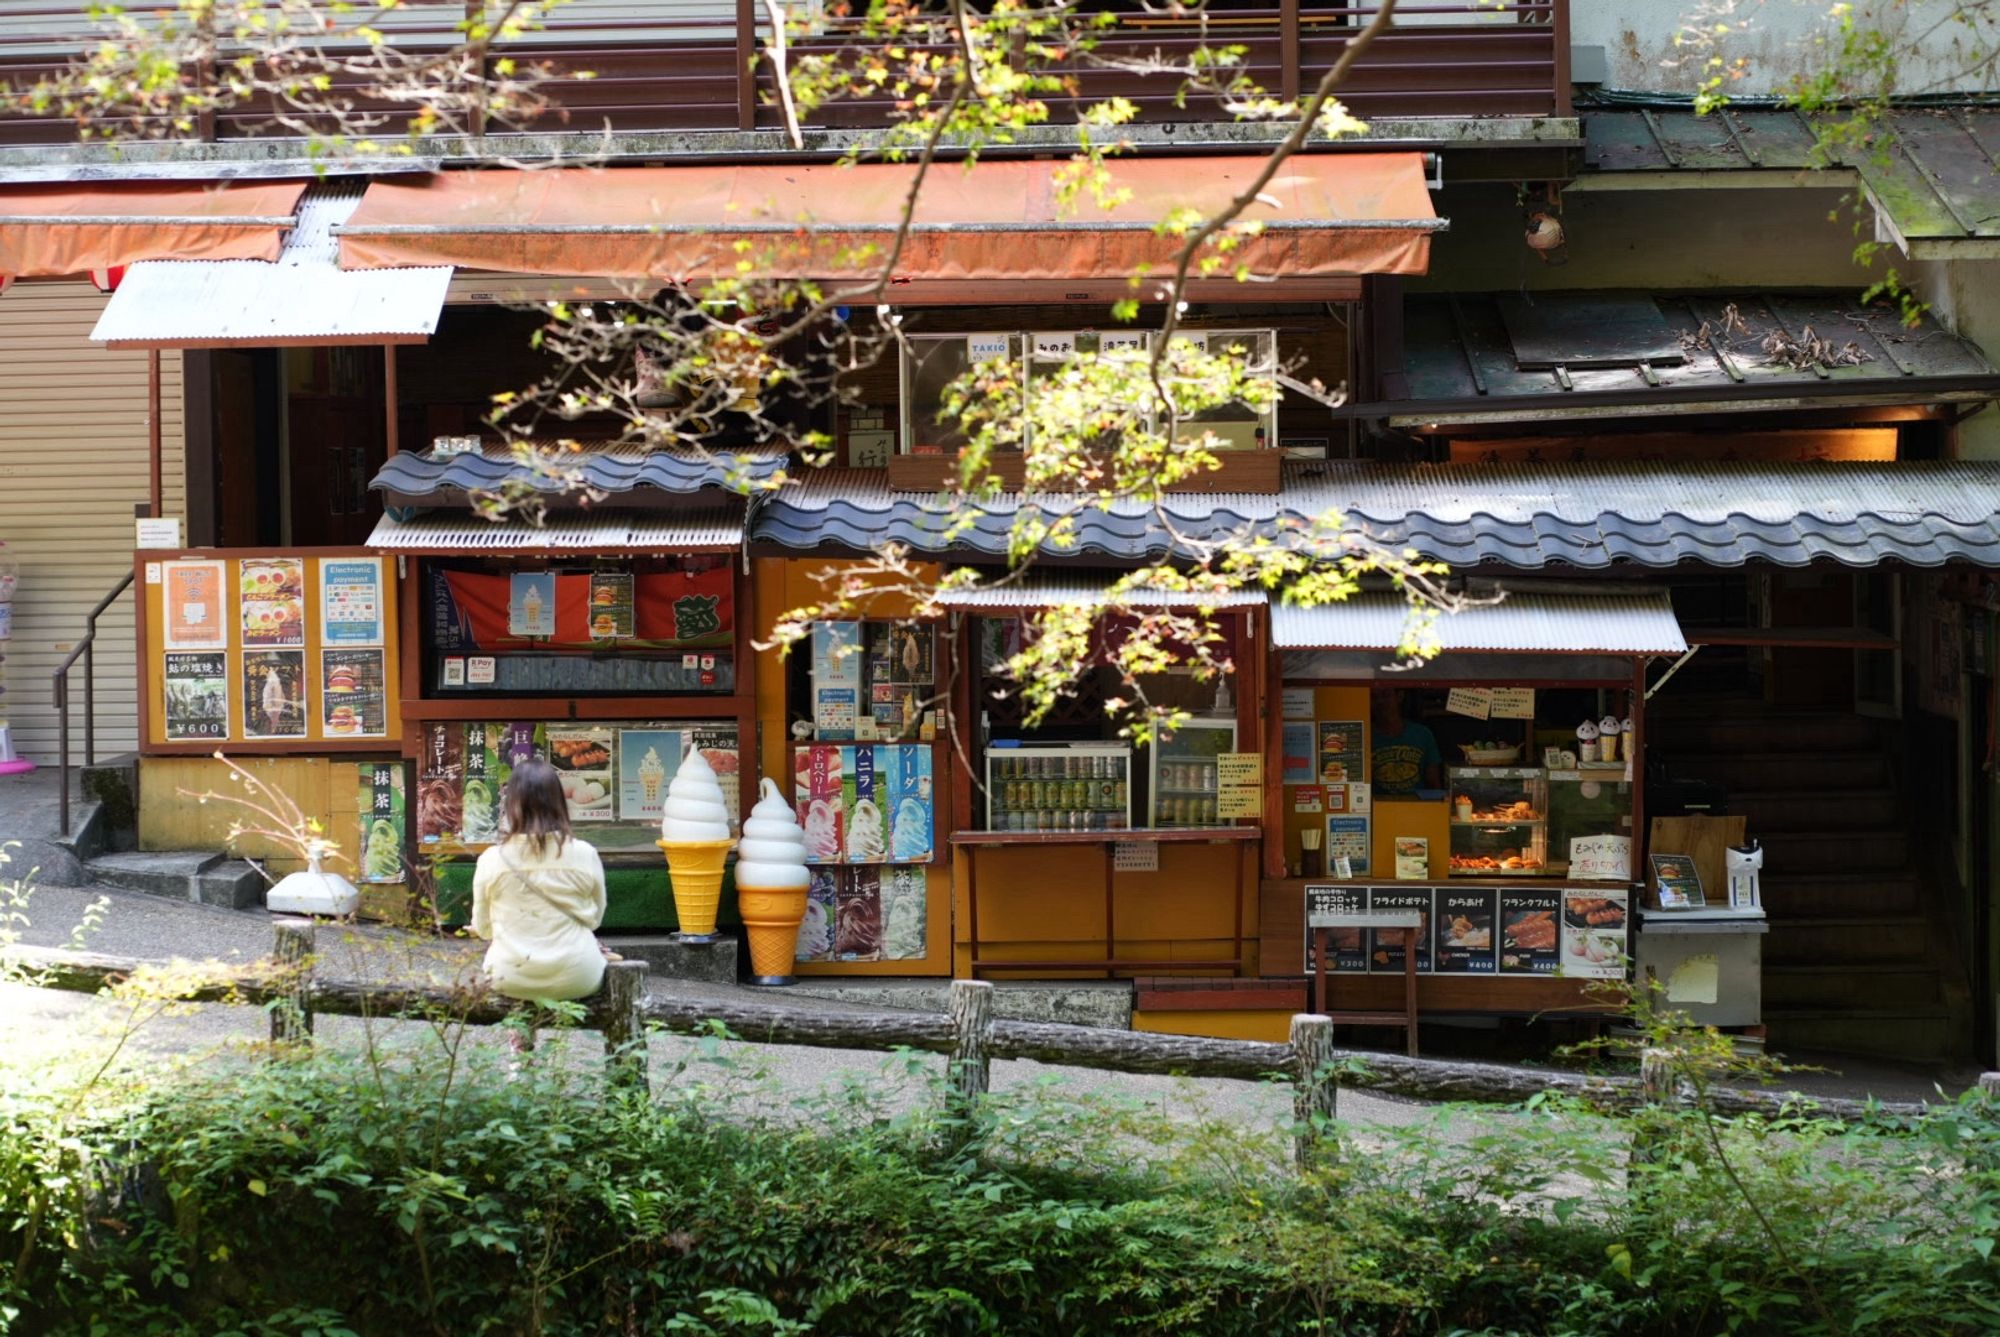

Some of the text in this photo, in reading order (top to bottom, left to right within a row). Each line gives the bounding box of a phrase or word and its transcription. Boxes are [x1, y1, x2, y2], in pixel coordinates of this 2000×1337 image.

[972, 343, 1005, 352] TAKIO
[1039, 342, 1071, 352] みのお
[333, 576, 368, 584] payment
[168, 662, 223, 674] 鮎の塩焼き
[176, 723, 219, 734] ¥600
[434, 725, 445, 775] チョコレート
[468, 730, 483, 769] 抹茶
[903, 747, 916, 790] ソーダ
[374, 770, 389, 809] 抹茶
[1373, 897, 1430, 905] フライドポテト
[1448, 898, 1484, 907] からあげ
[1502, 898, 1559, 907] フランクフルト
